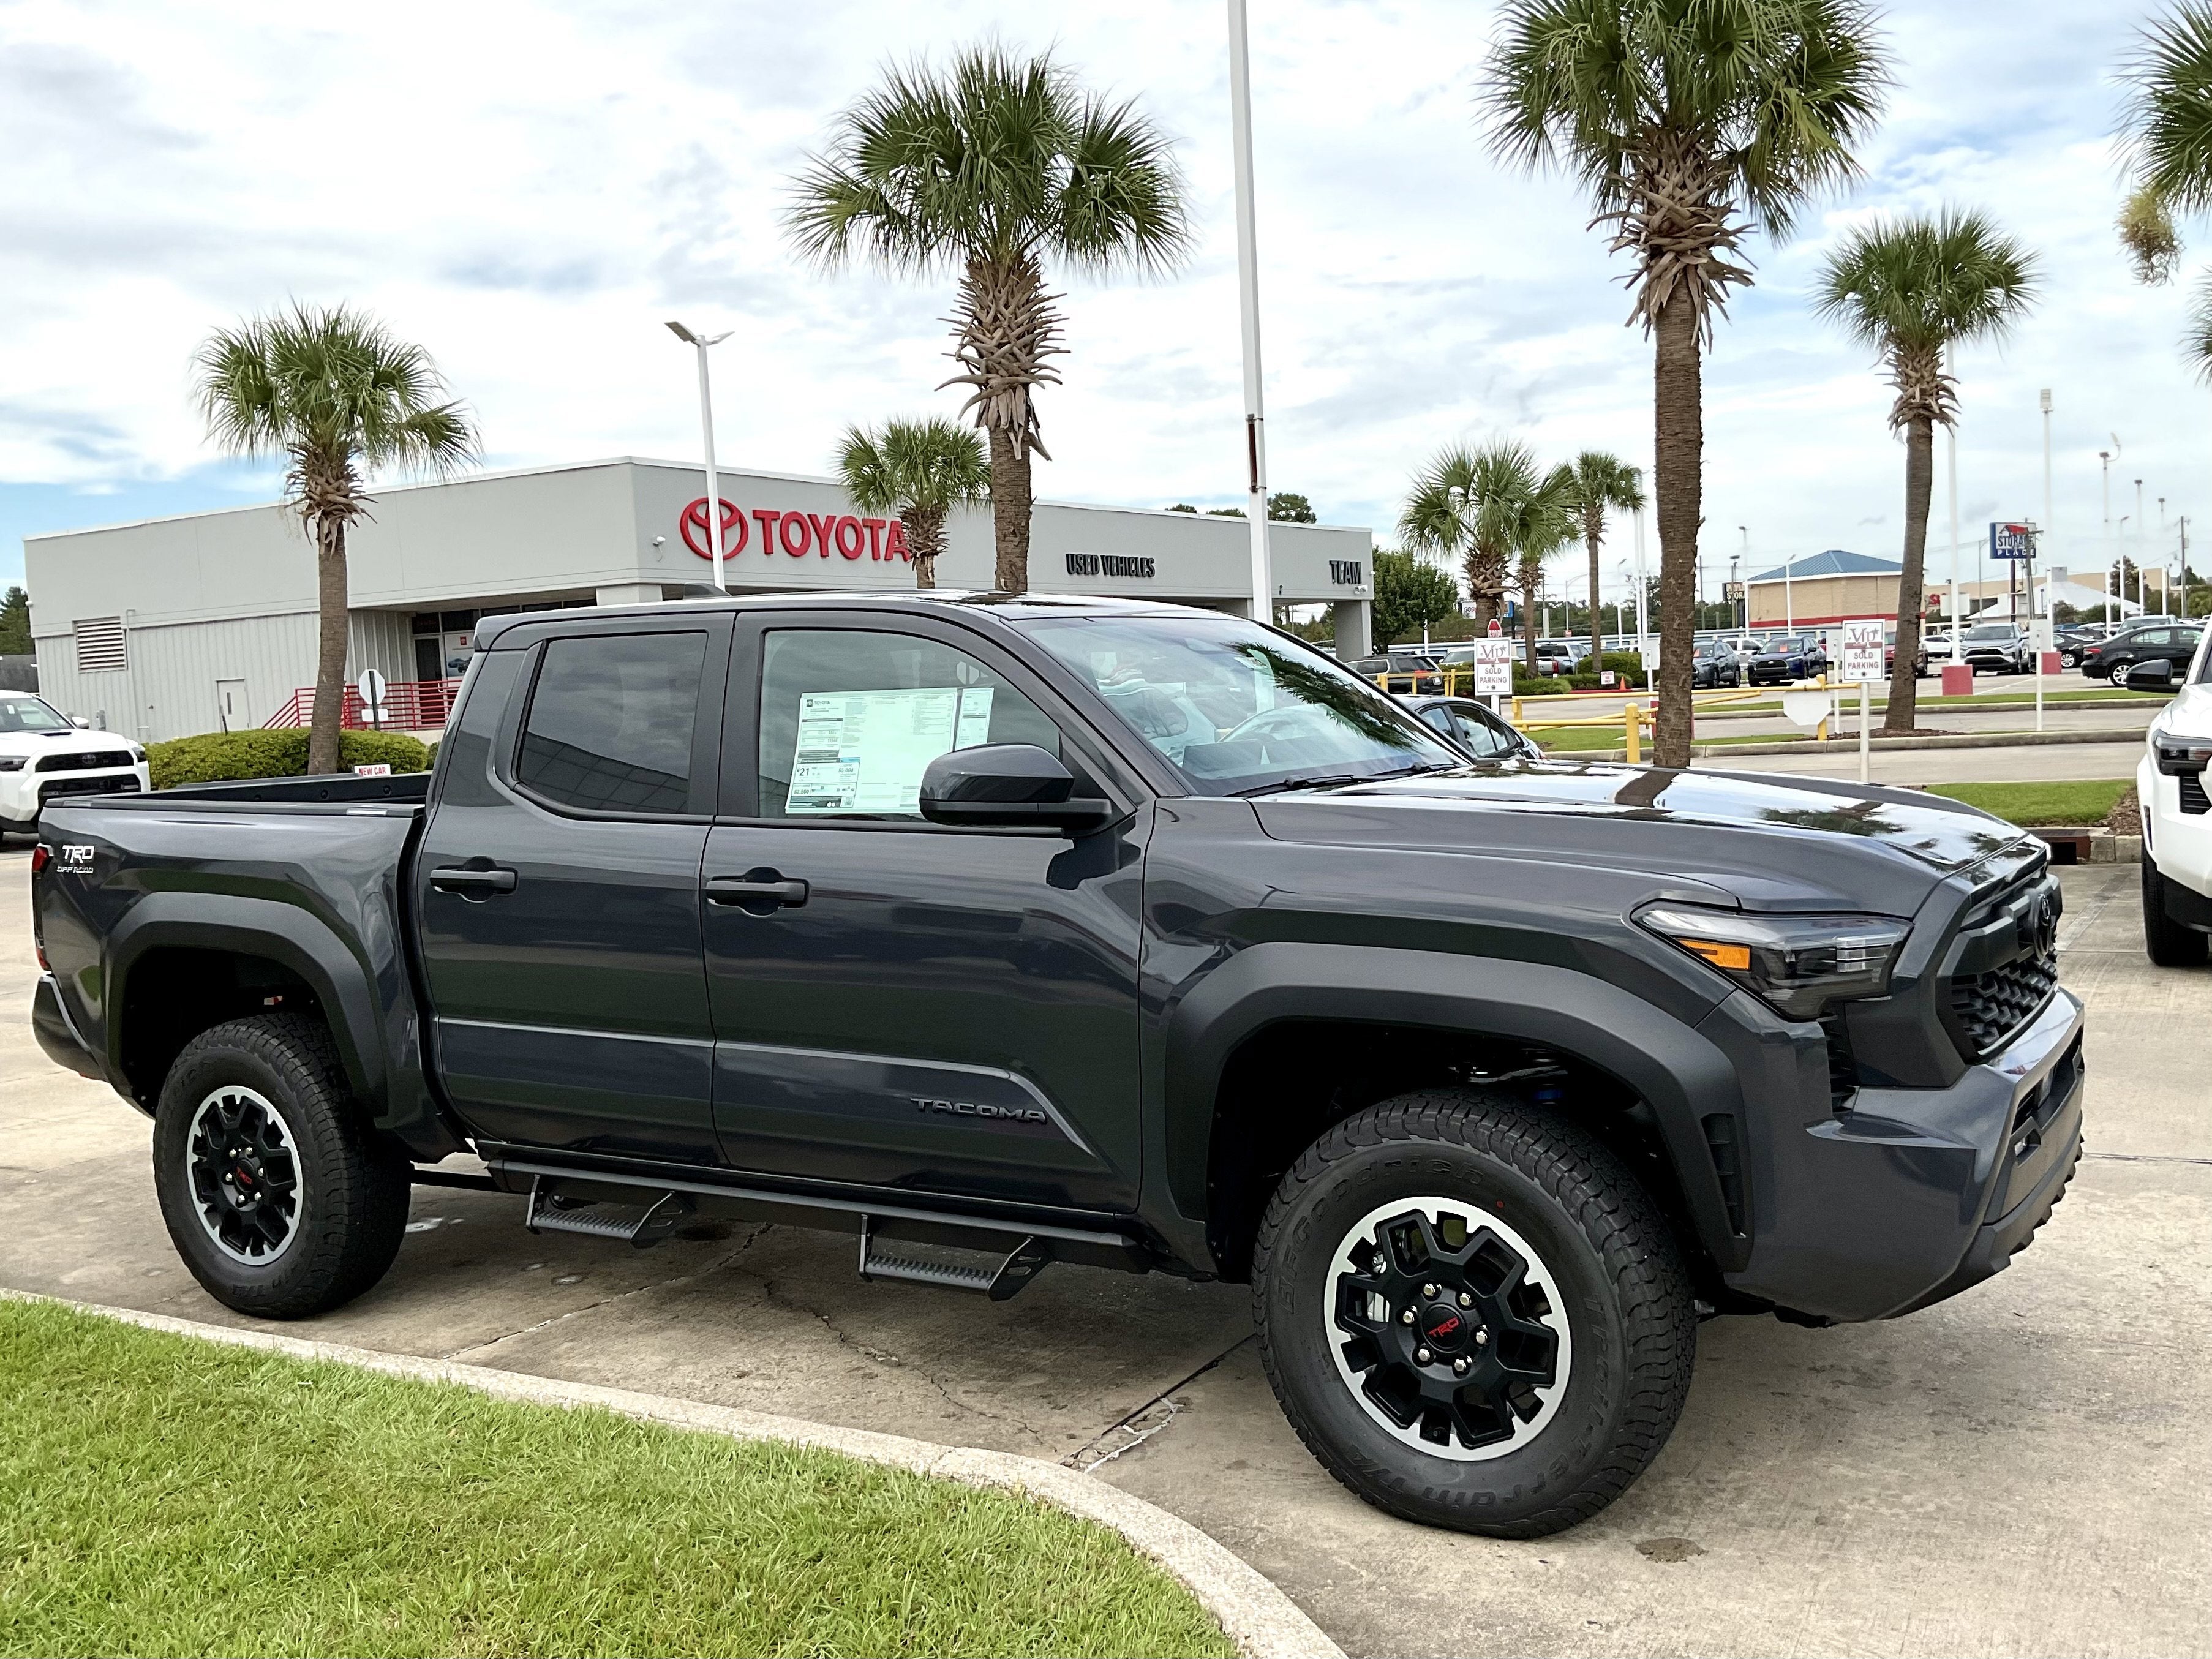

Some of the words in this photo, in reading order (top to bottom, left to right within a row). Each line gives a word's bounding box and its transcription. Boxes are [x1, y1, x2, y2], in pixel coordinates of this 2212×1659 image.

[753, 510, 911, 562] TOYOTA
[1998, 535, 2034, 547] STORAE
[1066, 554, 1100, 574] USED
[1100, 555, 1156, 577] VEHICLES
[1329, 560, 1361, 584] TEAM
[359, 767, 372, 776] NEW
[799, 767, 809, 777] 21
[62, 845, 94, 863] TRD
[911, 1097, 1047, 1124] TACOMA
[1428, 1317, 1460, 1337] TRD
